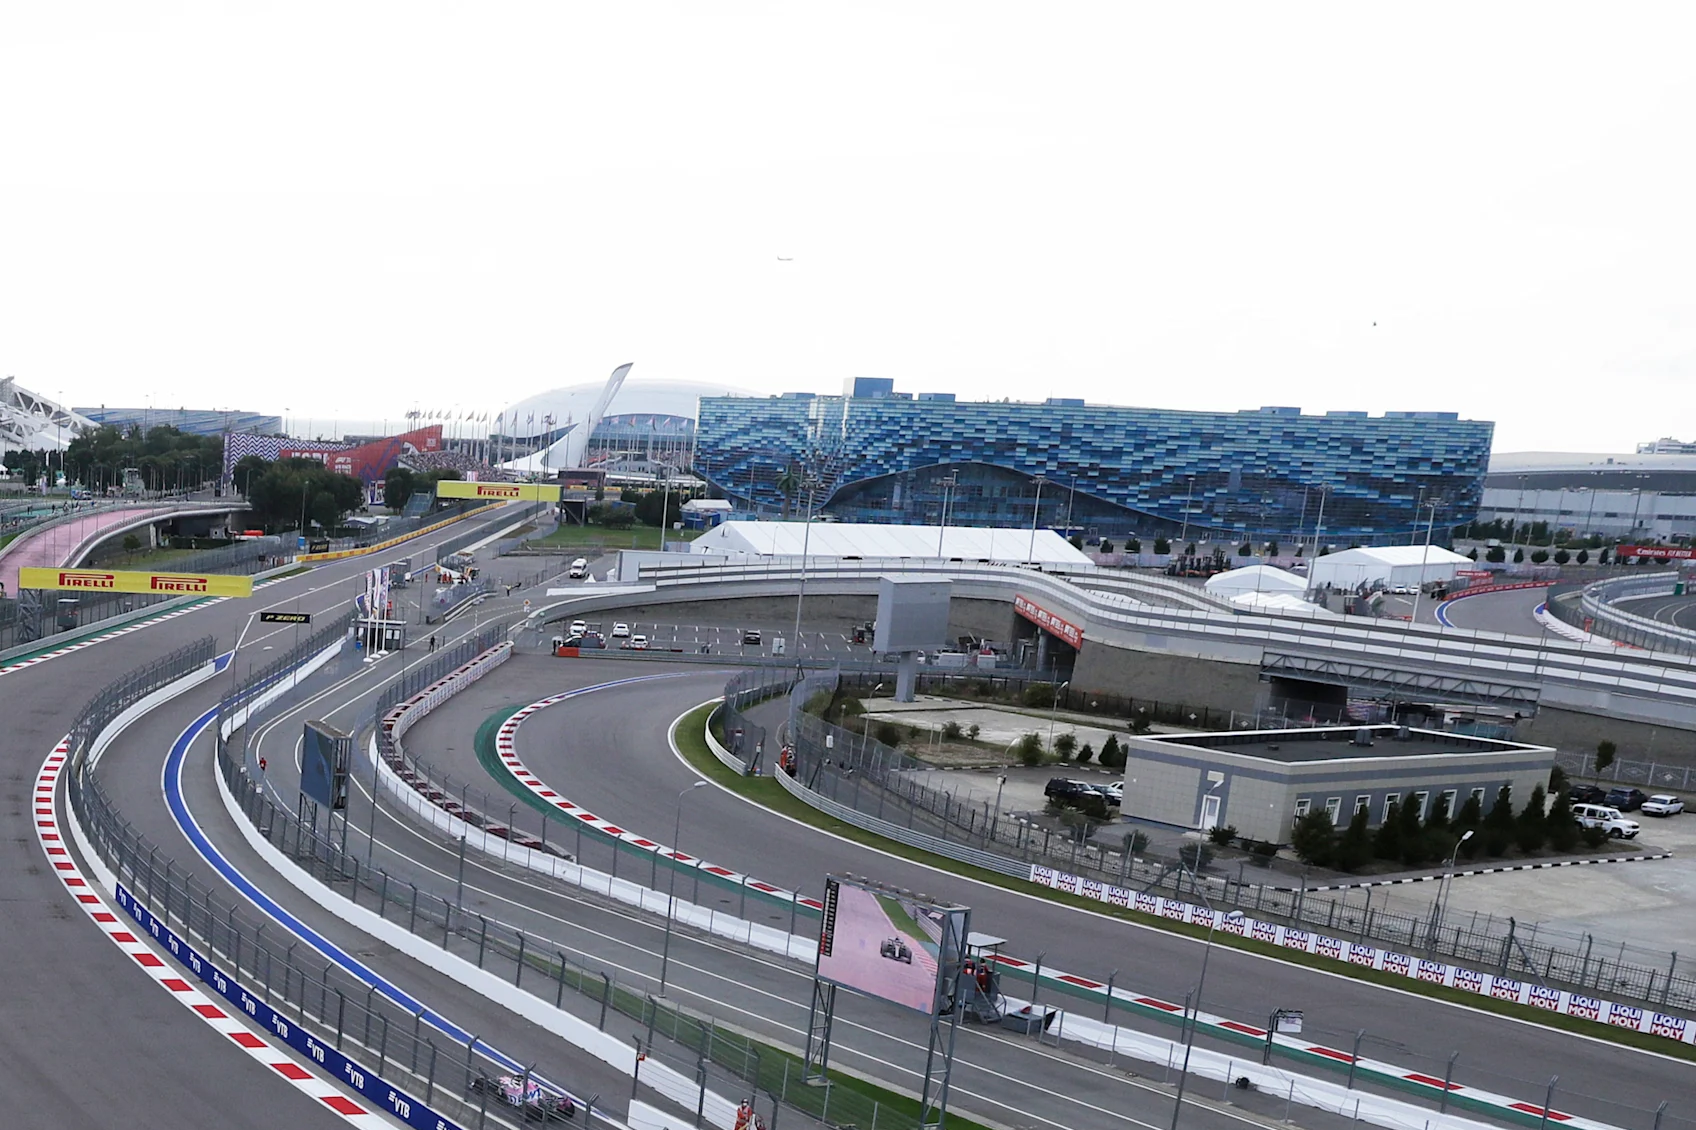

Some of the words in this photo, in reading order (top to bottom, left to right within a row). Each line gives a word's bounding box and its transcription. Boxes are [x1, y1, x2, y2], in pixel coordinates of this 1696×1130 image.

[477, 486, 520, 497] PIRELLI
[59, 573, 115, 588] PIRELLI
[151, 576, 208, 592] PIRELLI
[1035, 866, 1052, 876] LIQUI
[1058, 872, 1076, 884] LIQUI
[1084, 879, 1102, 890] LIQUI
[1109, 887, 1128, 898] LIQUI
[1136, 892, 1156, 904] LIQUI
[1108, 895, 1128, 906] MOLY
[1164, 899, 1184, 912] LIQUI
[1135, 902, 1155, 913] MOLY
[1193, 906, 1214, 918] LIQUI
[1163, 909, 1184, 920] MOLY
[1192, 915, 1213, 927] MOLY
[1222, 923, 1244, 935] MOLY
[1254, 920, 1275, 933] LIQUI
[1252, 930, 1275, 942] MOLY
[1285, 928, 1308, 941] LIQUI
[1284, 938, 1307, 951] MOLY
[1317, 936, 1341, 949] LIQUI
[1316, 946, 1340, 959] MOLY
[1351, 944, 1374, 957] LIQUI
[1349, 954, 1373, 967] MOLY
[1385, 952, 1409, 966] LIQUI
[1383, 963, 1408, 975] MOLY
[1420, 960, 1445, 974] LIQUI
[1418, 971, 1444, 984] MOLY
[1456, 969, 1482, 982] LIQUI
[1454, 979, 1481, 992] MOLY
[1494, 978, 1520, 990] LIQUI
[1491, 988, 1519, 1002] MOLY
[1531, 987, 1559, 1000] LIQUI
[1529, 996, 1558, 1010] MOLY
[1570, 994, 1600, 1009] LIQUI
[1568, 1005, 1599, 1019] MOLY
[1611, 1004, 1642, 1019] LIQUI
[1609, 1015, 1640, 1030] MOLY
[1654, 1014, 1685, 1029] LIQUI
[277, 1020, 289, 1038] VTB
[1652, 1025, 1683, 1040] MOLY
[312, 1044, 325, 1062] VTB
[351, 1070, 364, 1089] VTB
[394, 1097, 411, 1119] VTB
